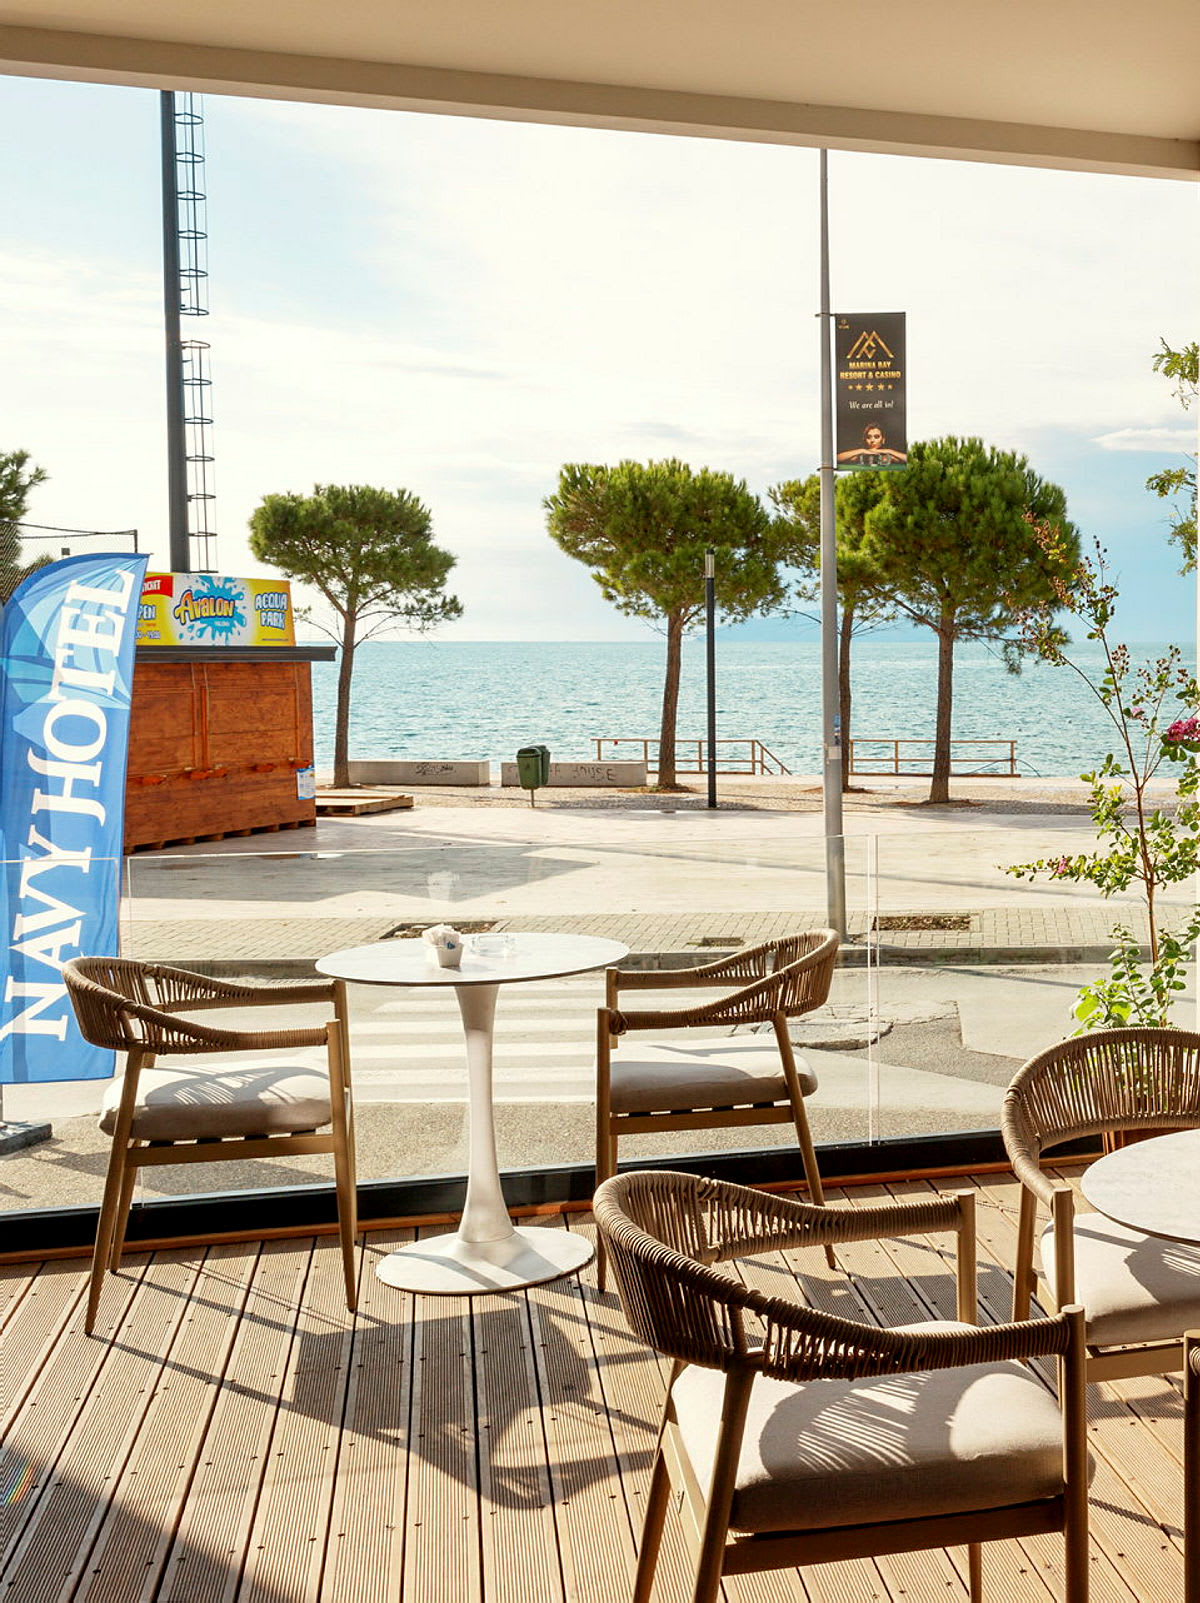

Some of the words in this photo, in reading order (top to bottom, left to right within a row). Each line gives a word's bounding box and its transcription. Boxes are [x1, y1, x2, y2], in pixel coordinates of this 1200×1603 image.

[849, 361, 876, 369] MARINA
[878, 361, 891, 369] BAY
[840, 371, 866, 379] RESORT
[867, 371, 874, 379] &
[875, 371, 901, 379] CASINO
[849, 400, 860, 409] We
[873, 400, 883, 409] all
[884, 400, 894, 409] in!
[255, 592, 288, 611] ACQUA
[137, 604, 156, 620] PEN
[260, 611, 286, 630] PARK
[27, 569, 136, 826] HOTEL
[0, 824, 92, 1041] NAVY
